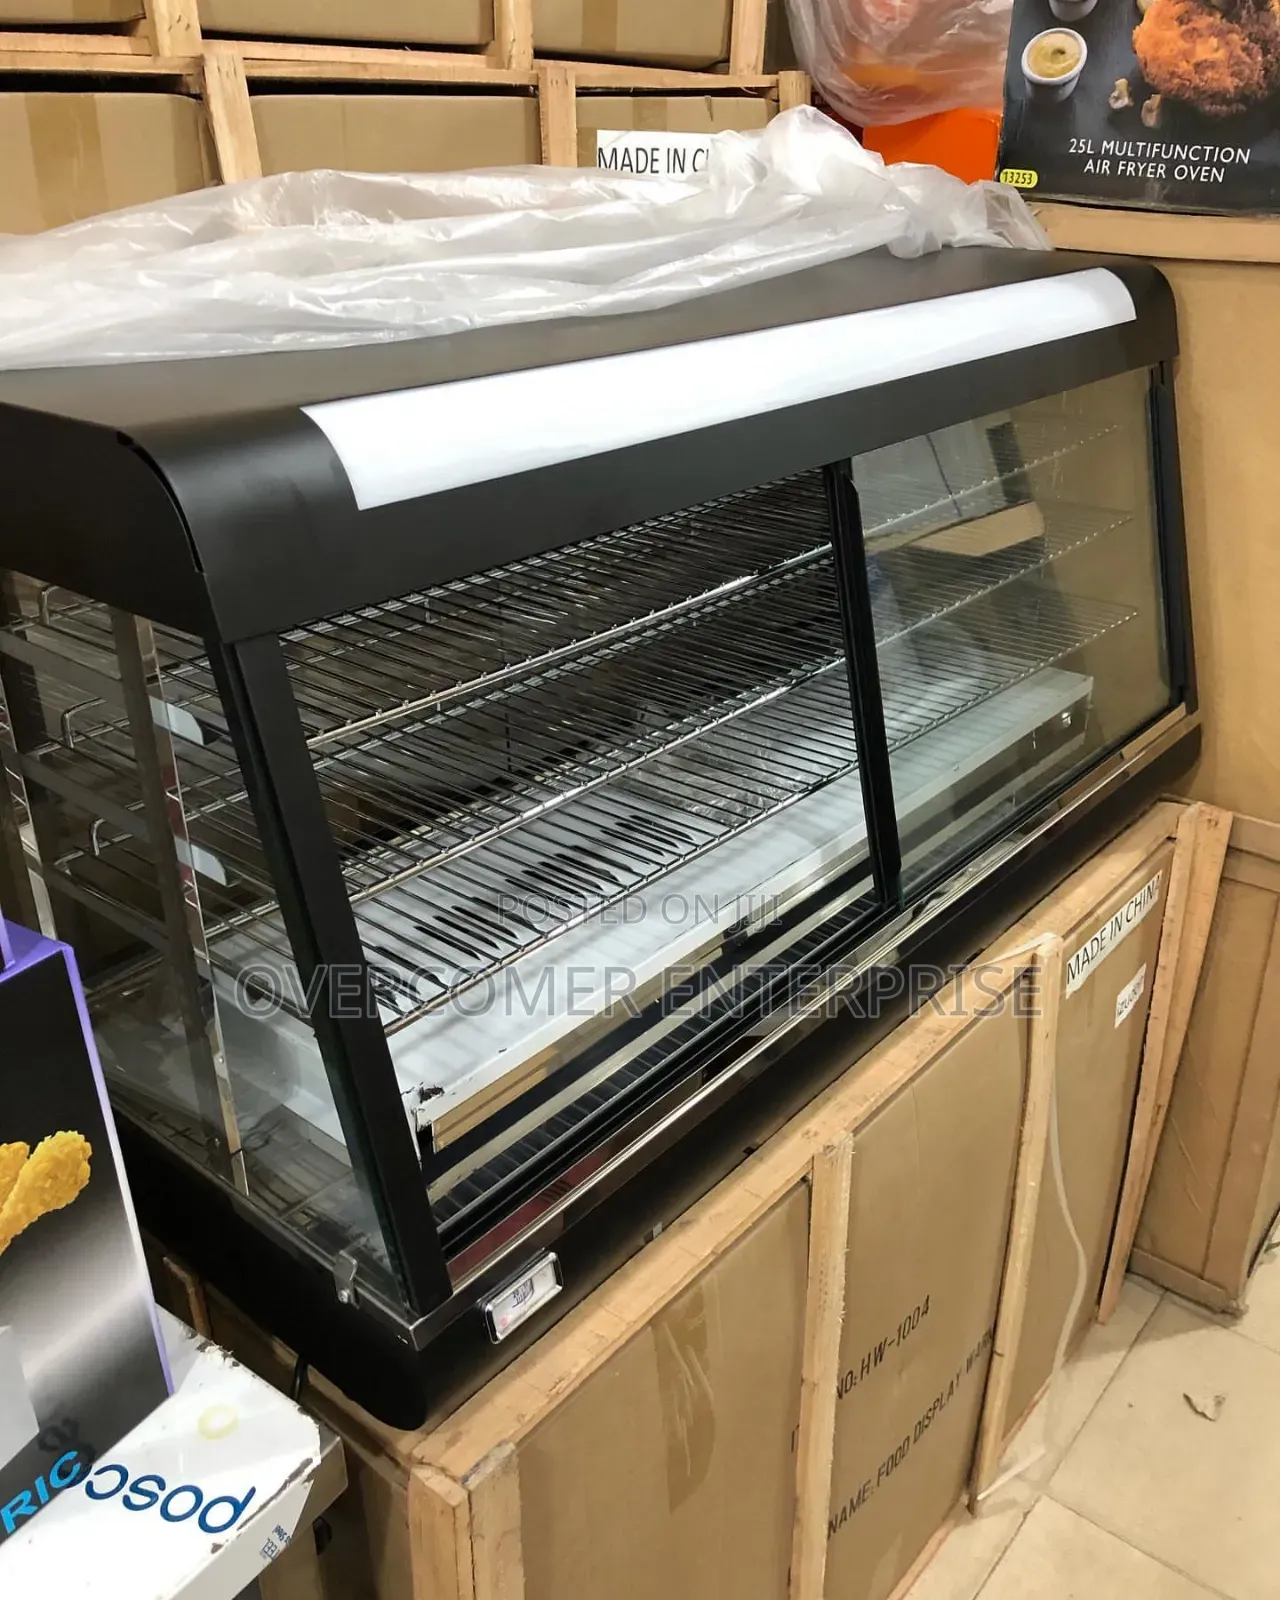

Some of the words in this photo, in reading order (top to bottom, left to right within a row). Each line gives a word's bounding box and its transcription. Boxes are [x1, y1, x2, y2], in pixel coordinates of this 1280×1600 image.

[598, 147, 660, 174] MADE
[667, 148, 686, 174] IN
[1068, 138, 1095, 155] 25L
[1101, 140, 1251, 165] MULTIFUNCTION
[1002, 170, 1033, 185] 13253
[1083, 159, 1110, 176] AIR
[1117, 161, 1167, 179] FRYER
[1174, 164, 1225, 183] OVEN
[1066, 928, 1107, 985] MADE
[1110, 911, 1124, 941] IN
[1125, 874, 1161, 923] CHINA
[877, 1435, 911, 1488] FOOD
[912, 1365, 962, 1445] DISPLAY
